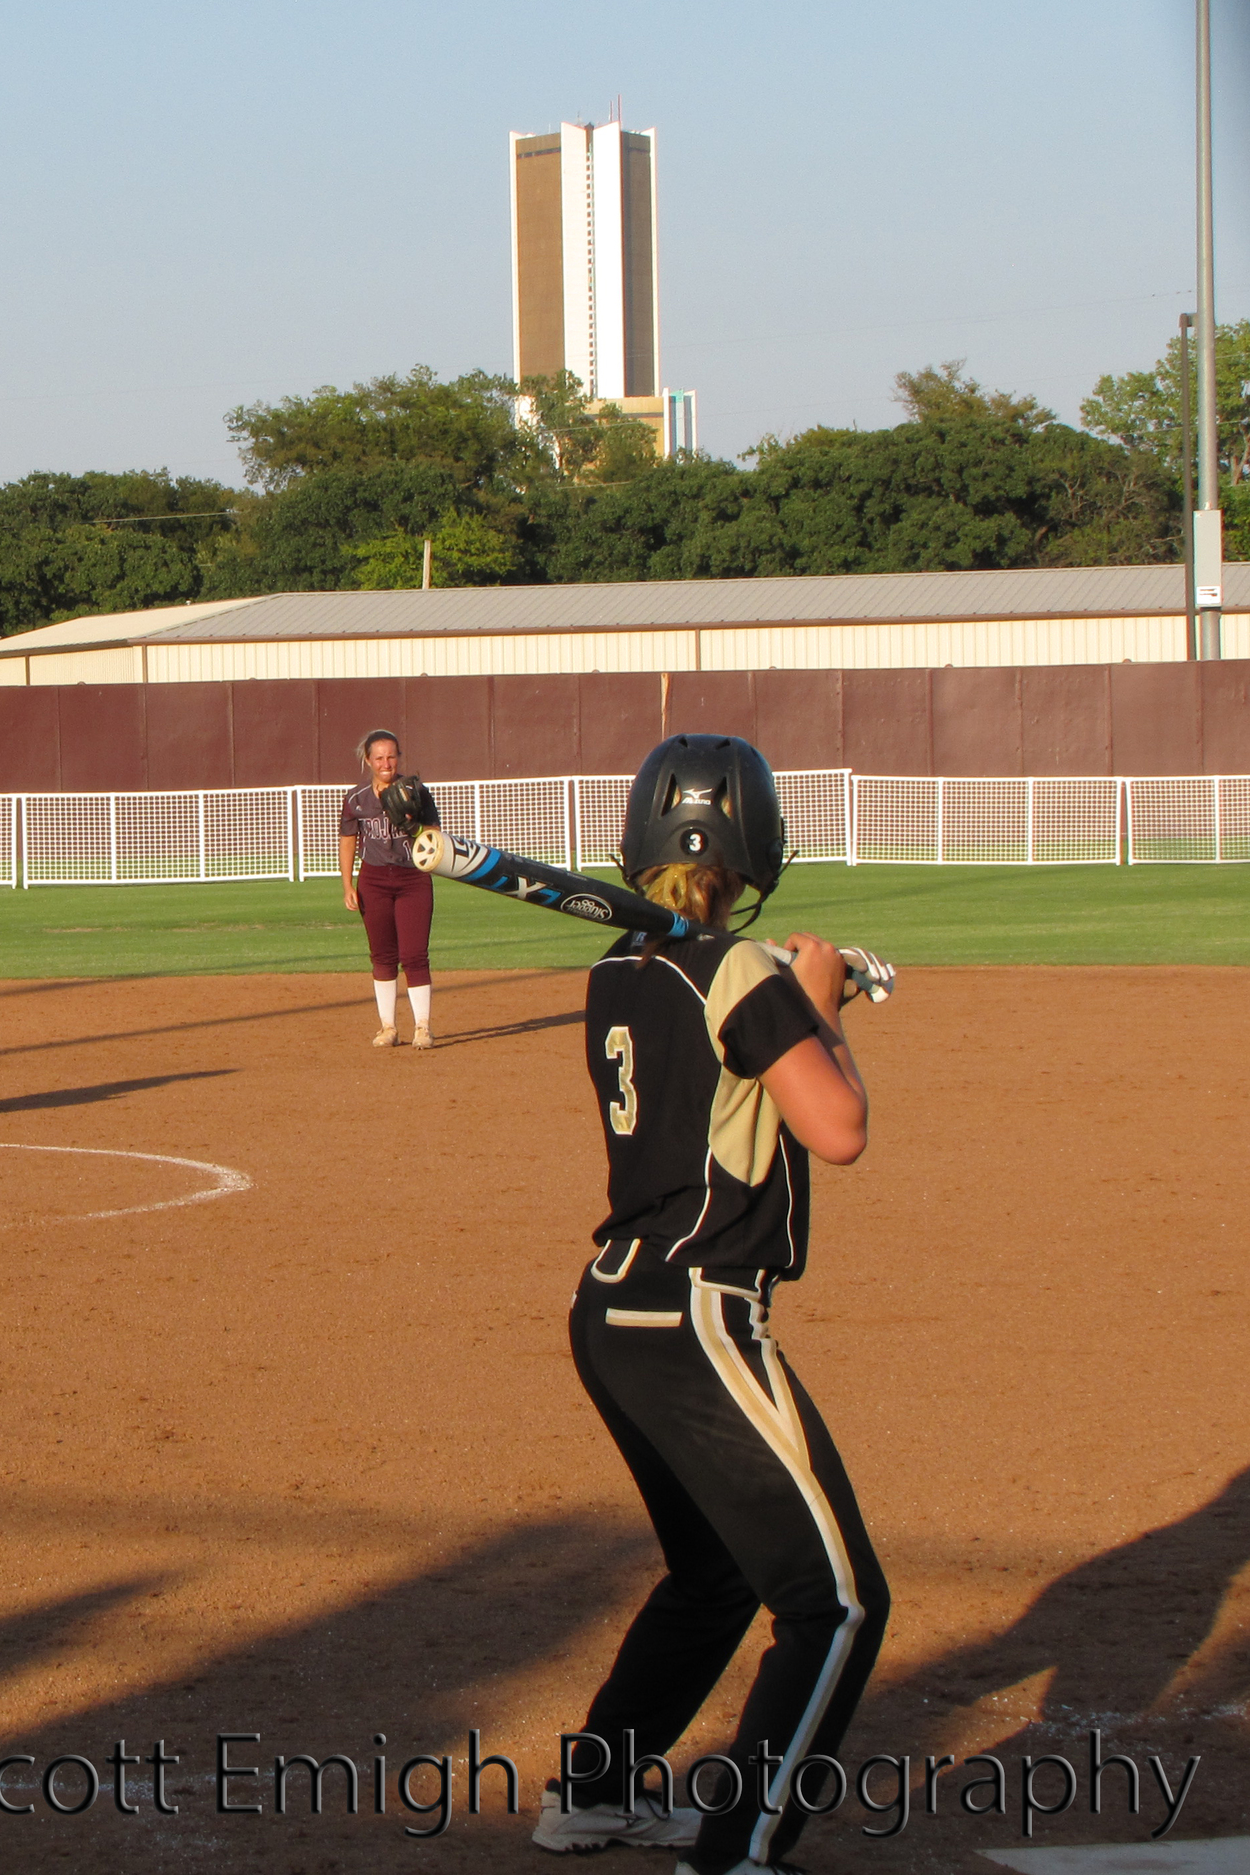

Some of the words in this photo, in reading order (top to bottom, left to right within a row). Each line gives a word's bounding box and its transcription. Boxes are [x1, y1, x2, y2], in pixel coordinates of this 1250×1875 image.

[689, 833, 703, 852] 3
[566, 899, 609, 919] Slugger
[605, 1026, 638, 1136] 3
